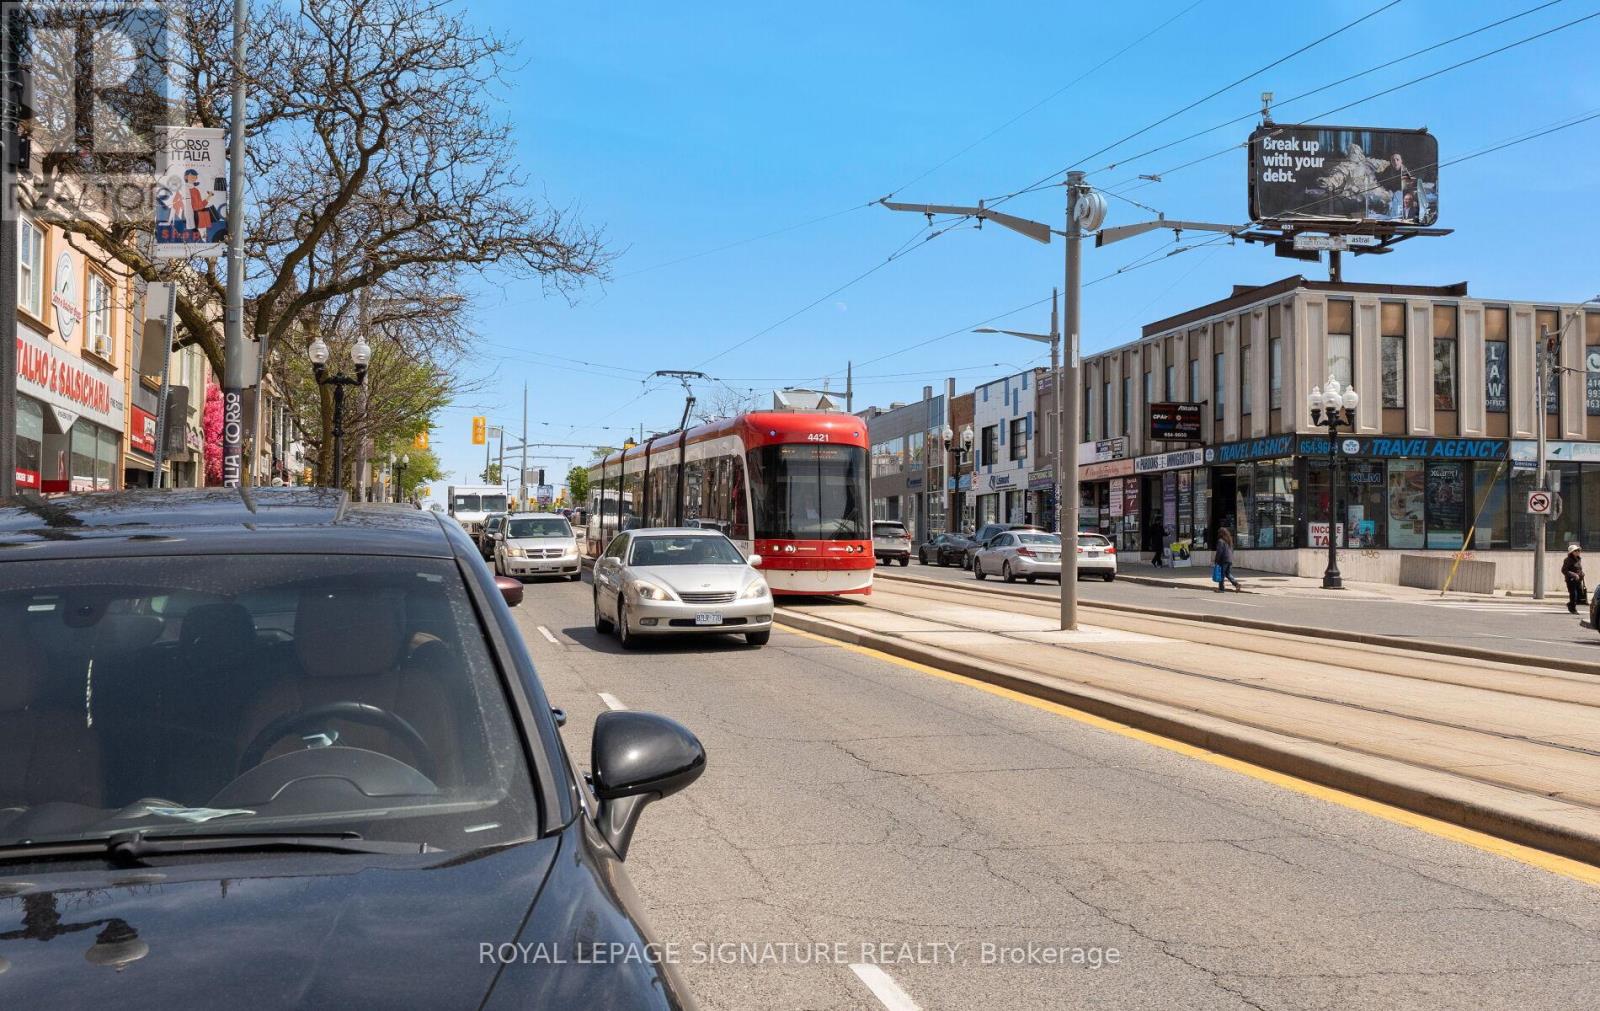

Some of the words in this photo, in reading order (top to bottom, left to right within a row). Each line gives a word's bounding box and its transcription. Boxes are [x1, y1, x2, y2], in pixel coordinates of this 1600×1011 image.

[171, 139, 210, 150] CORSO
[1263, 136, 1300, 151] Break
[1302, 140, 1320, 155] up
[171, 151, 211, 161] ITALIA
[1262, 152, 1293, 167] with
[1294, 156, 1325, 171] your
[1262, 168, 1297, 182] debt.
[1351, 236, 1370, 244] astral
[16, 337, 49, 388] TALHO
[50, 357, 57, 392] &
[59, 361, 110, 416] SALSICHARIA
[226, 392, 240, 444] CORSO
[807, 433, 829, 442] 4421
[1219, 443, 1249, 462] TRAVEL
[1251, 435, 1293, 457] AGENCY
[1371, 439, 1427, 456] TRAVEL
[1430, 440, 1504, 457] AGENCY
[225, 454, 240, 488] ALIA
[1350, 472, 1382, 483] KLM
[1311, 525, 1342, 534] INCOE
[1313, 535, 1338, 546] TA
